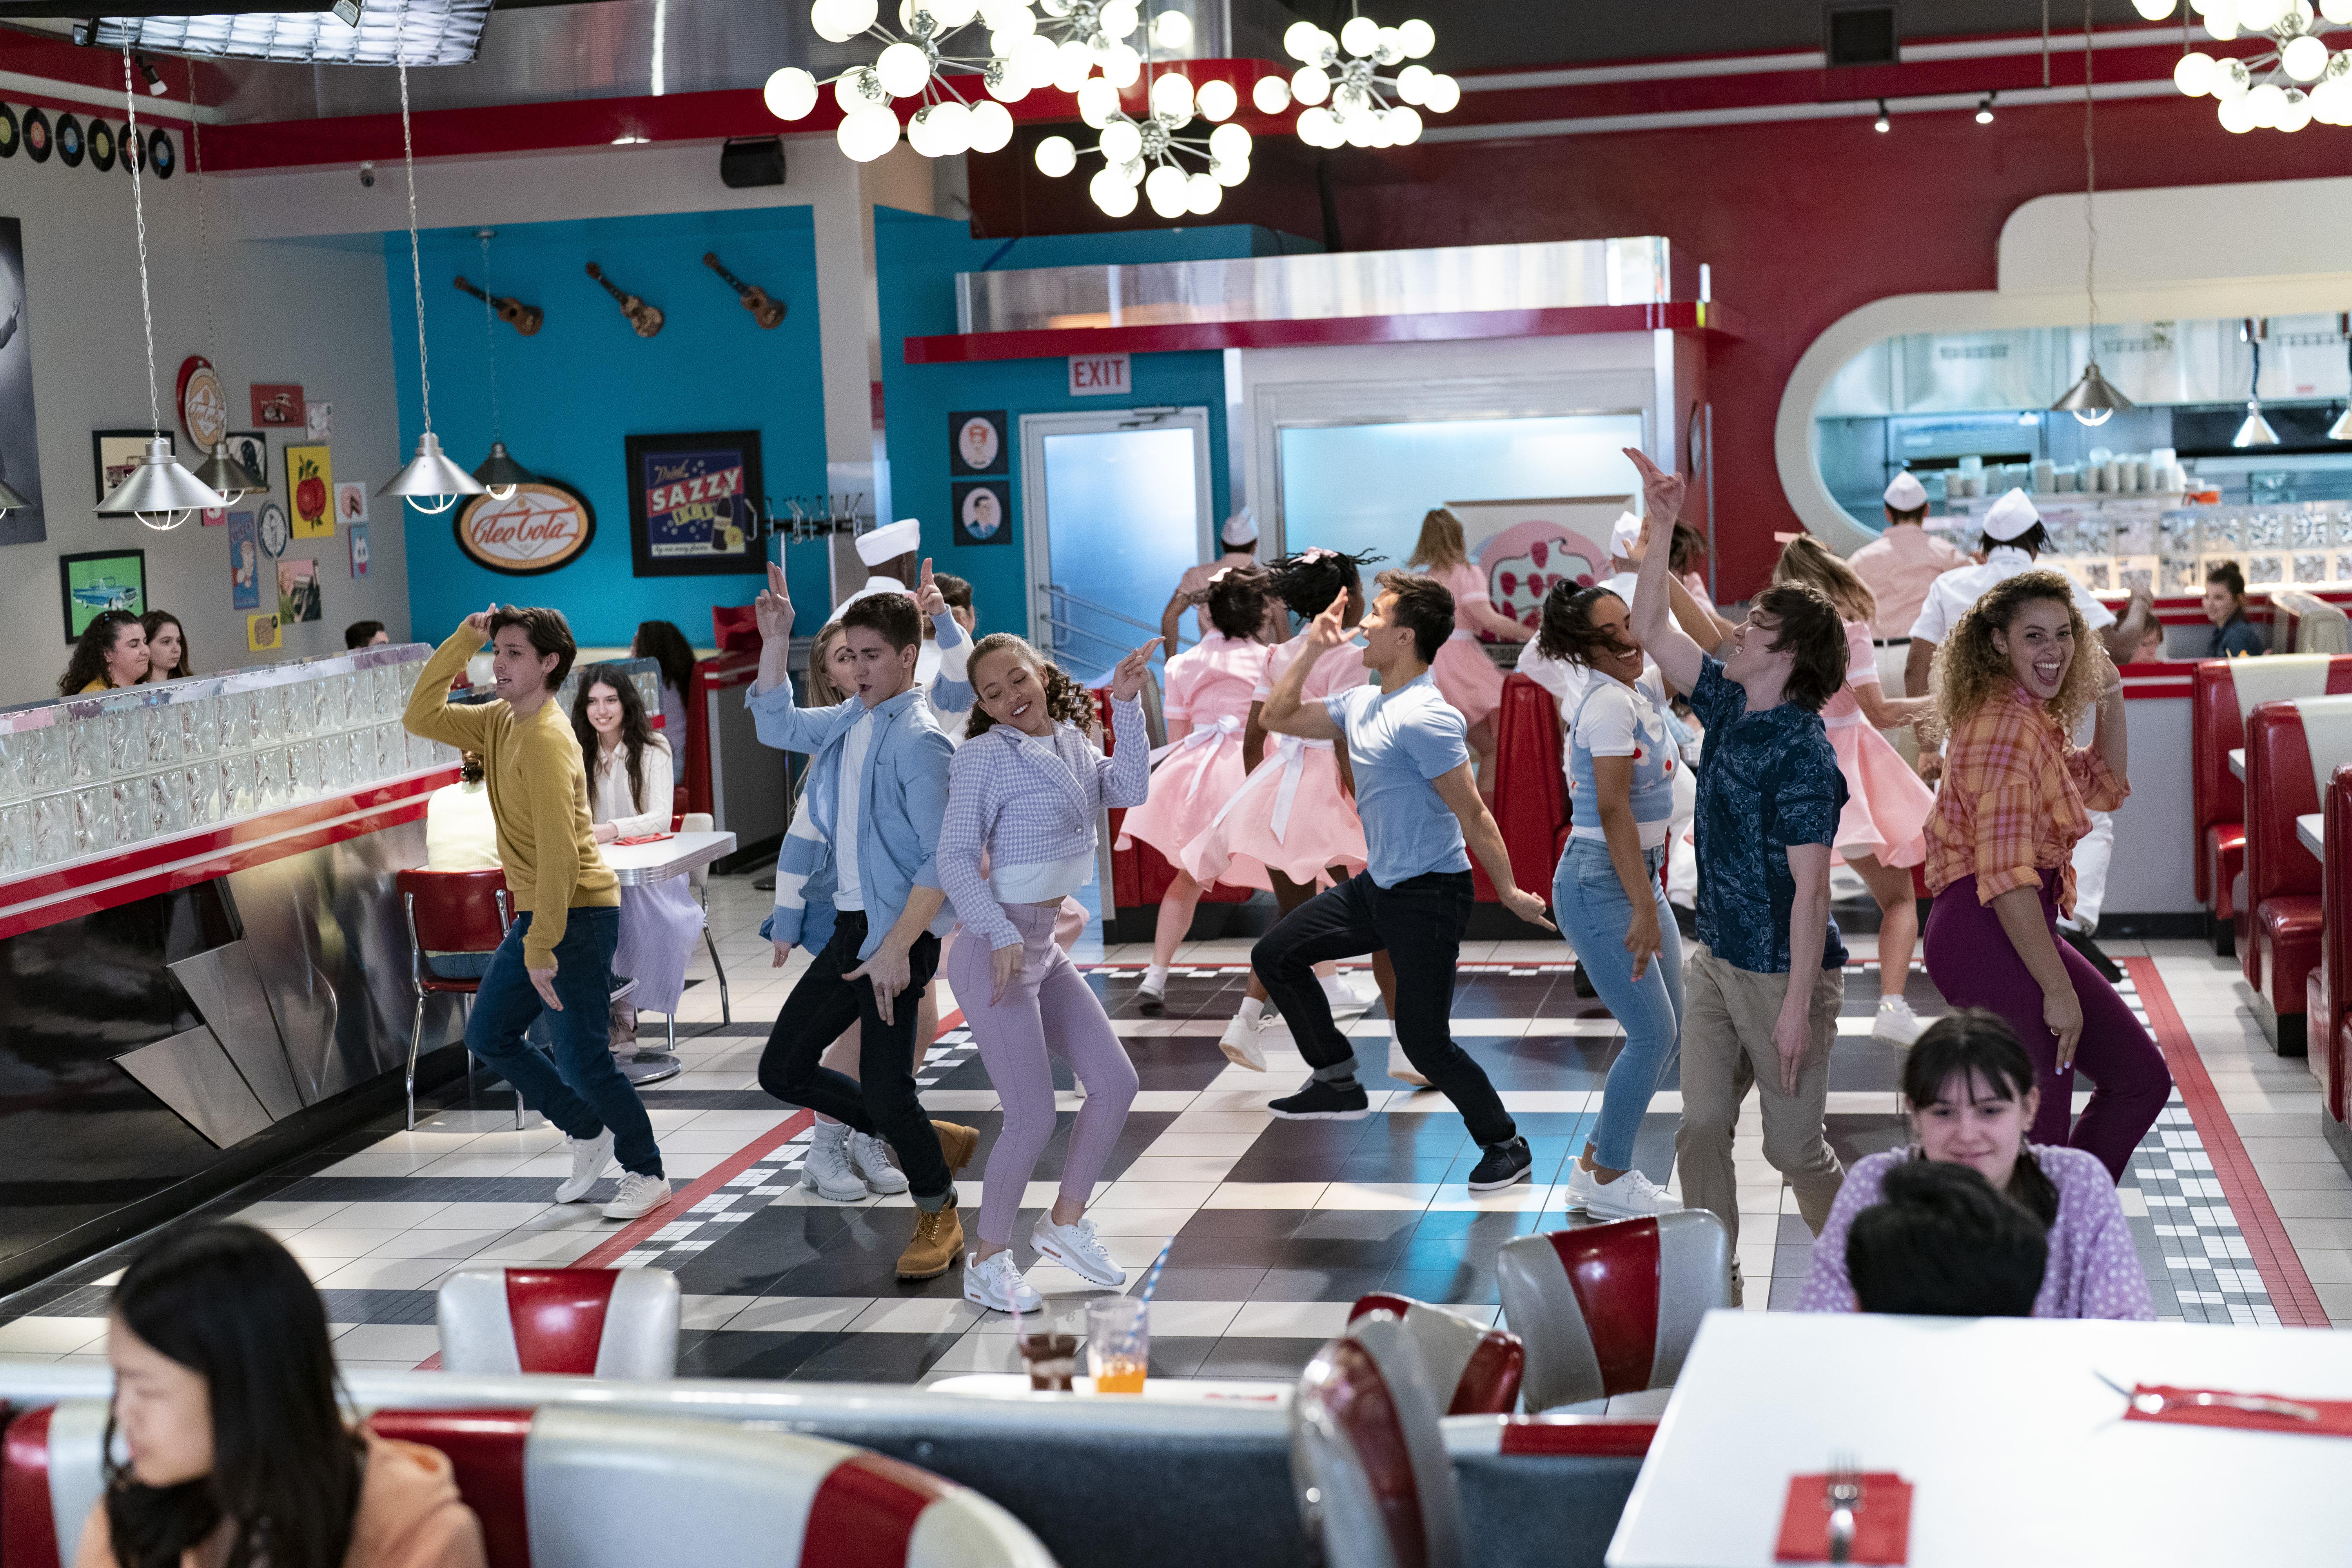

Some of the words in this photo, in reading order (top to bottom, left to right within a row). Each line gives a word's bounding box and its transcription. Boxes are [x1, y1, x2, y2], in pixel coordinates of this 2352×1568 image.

[1075, 360, 1123, 387] EXIT
[653, 469, 739, 511] SAZZY
[472, 508, 531, 544] Cleo
[518, 506, 579, 541] Cola
